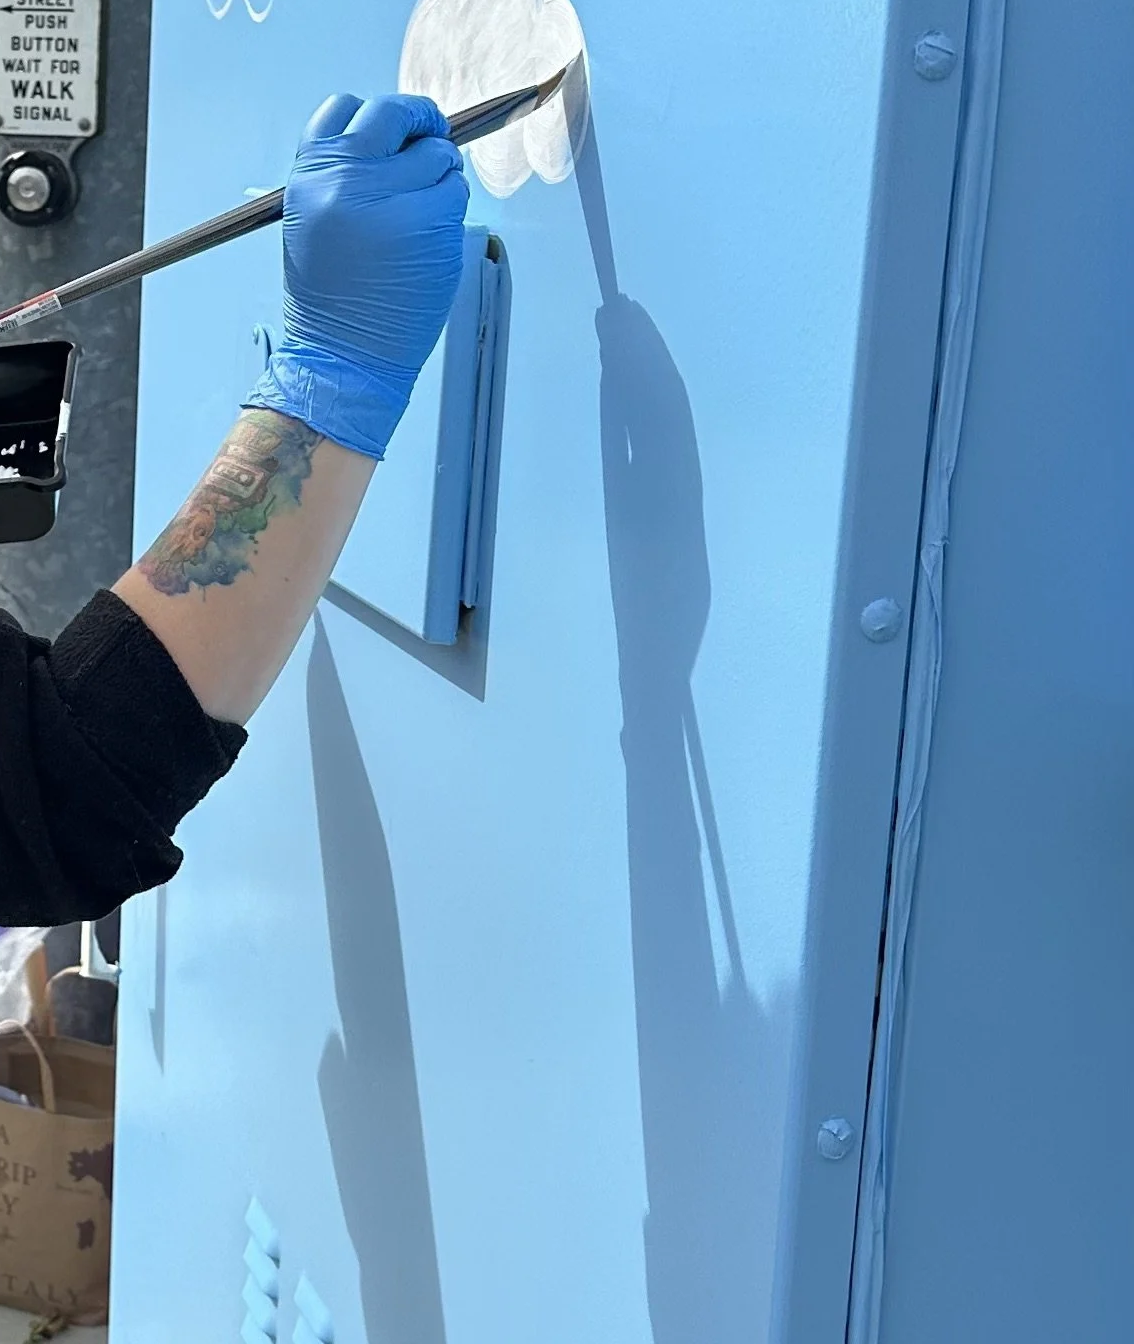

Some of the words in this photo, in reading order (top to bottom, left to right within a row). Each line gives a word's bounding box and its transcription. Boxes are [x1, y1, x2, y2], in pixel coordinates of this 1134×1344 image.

[25, 15, 68, 29] PUSH
[11, 36, 78, 52] BUTTON
[3, 59, 41, 74] WAIT
[51, 60, 80, 75] FOR
[11, 80, 74, 100] WALK
[14, 106, 72, 121] SIGNAL
